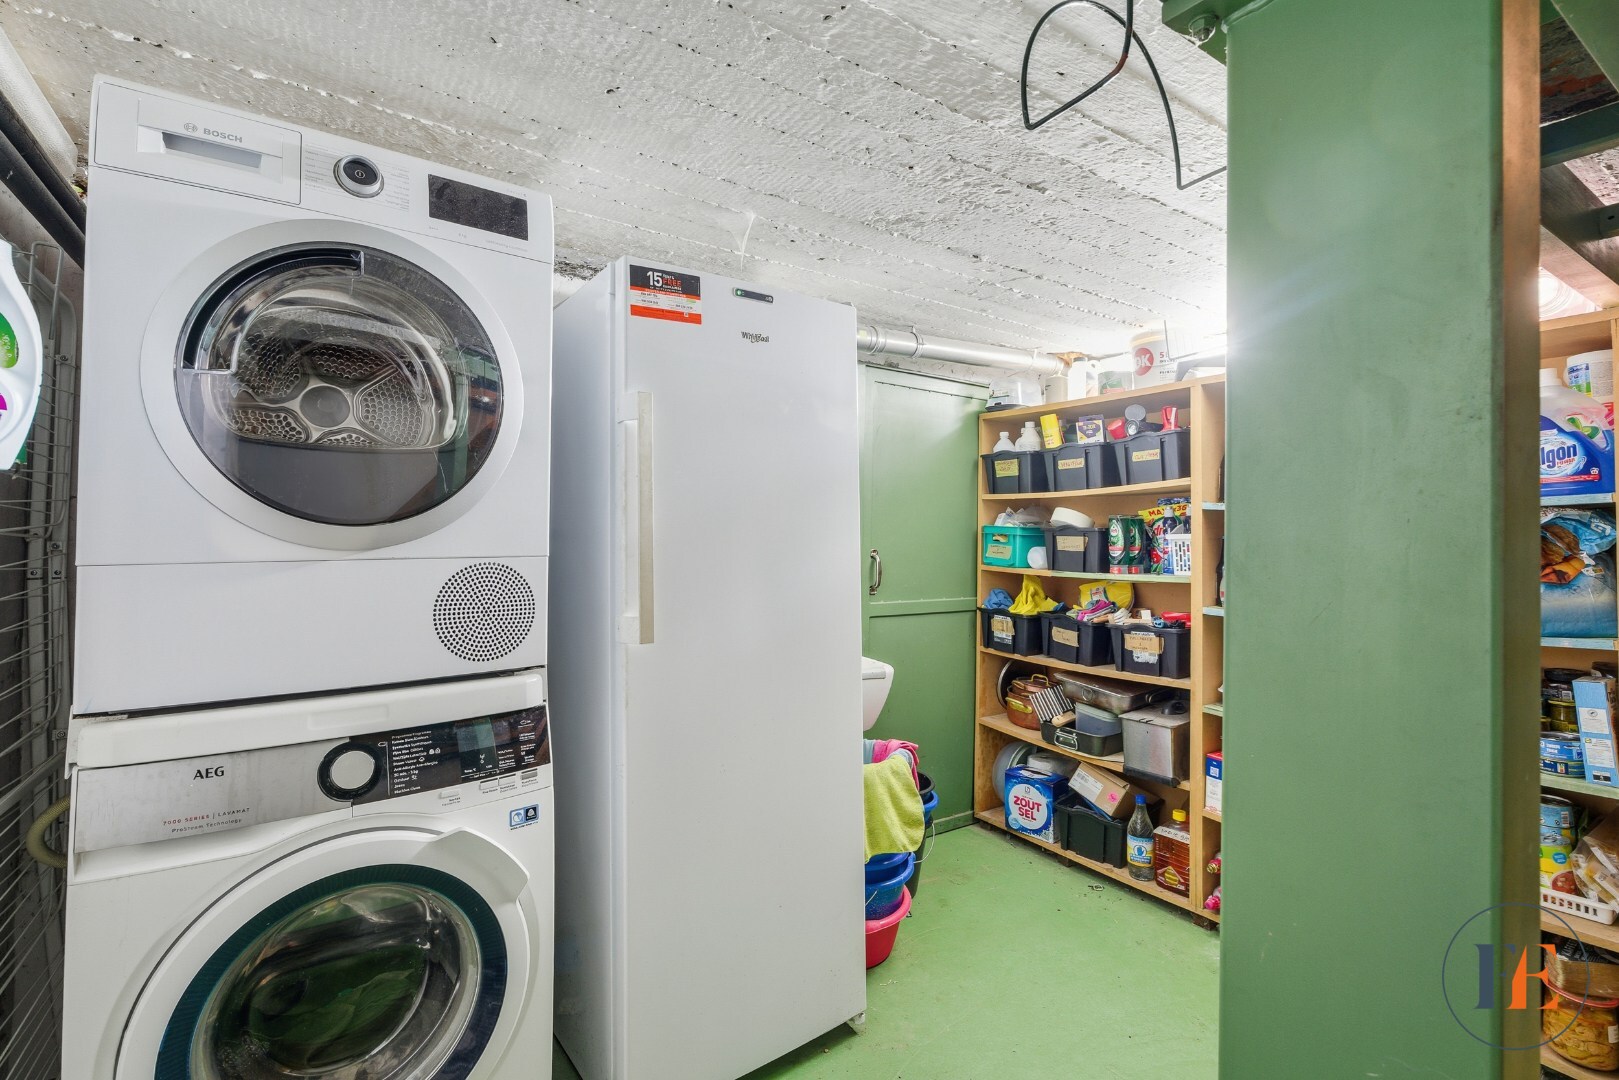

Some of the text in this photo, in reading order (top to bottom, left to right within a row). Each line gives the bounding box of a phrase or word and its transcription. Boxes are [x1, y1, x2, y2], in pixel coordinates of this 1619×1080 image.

[203, 127, 243, 143] BOSCH
[646, 270, 662, 287] 15
[662, 278, 682, 287] FREE
[193, 766, 225, 781] AEG
[1013, 795, 1042, 812] ZOUT
[162, 807, 250, 826] 7000 SERIES LAVAMAT
[1018, 807, 1037, 821] SEL
[171, 818, 242, 833] ProSteam Technology
